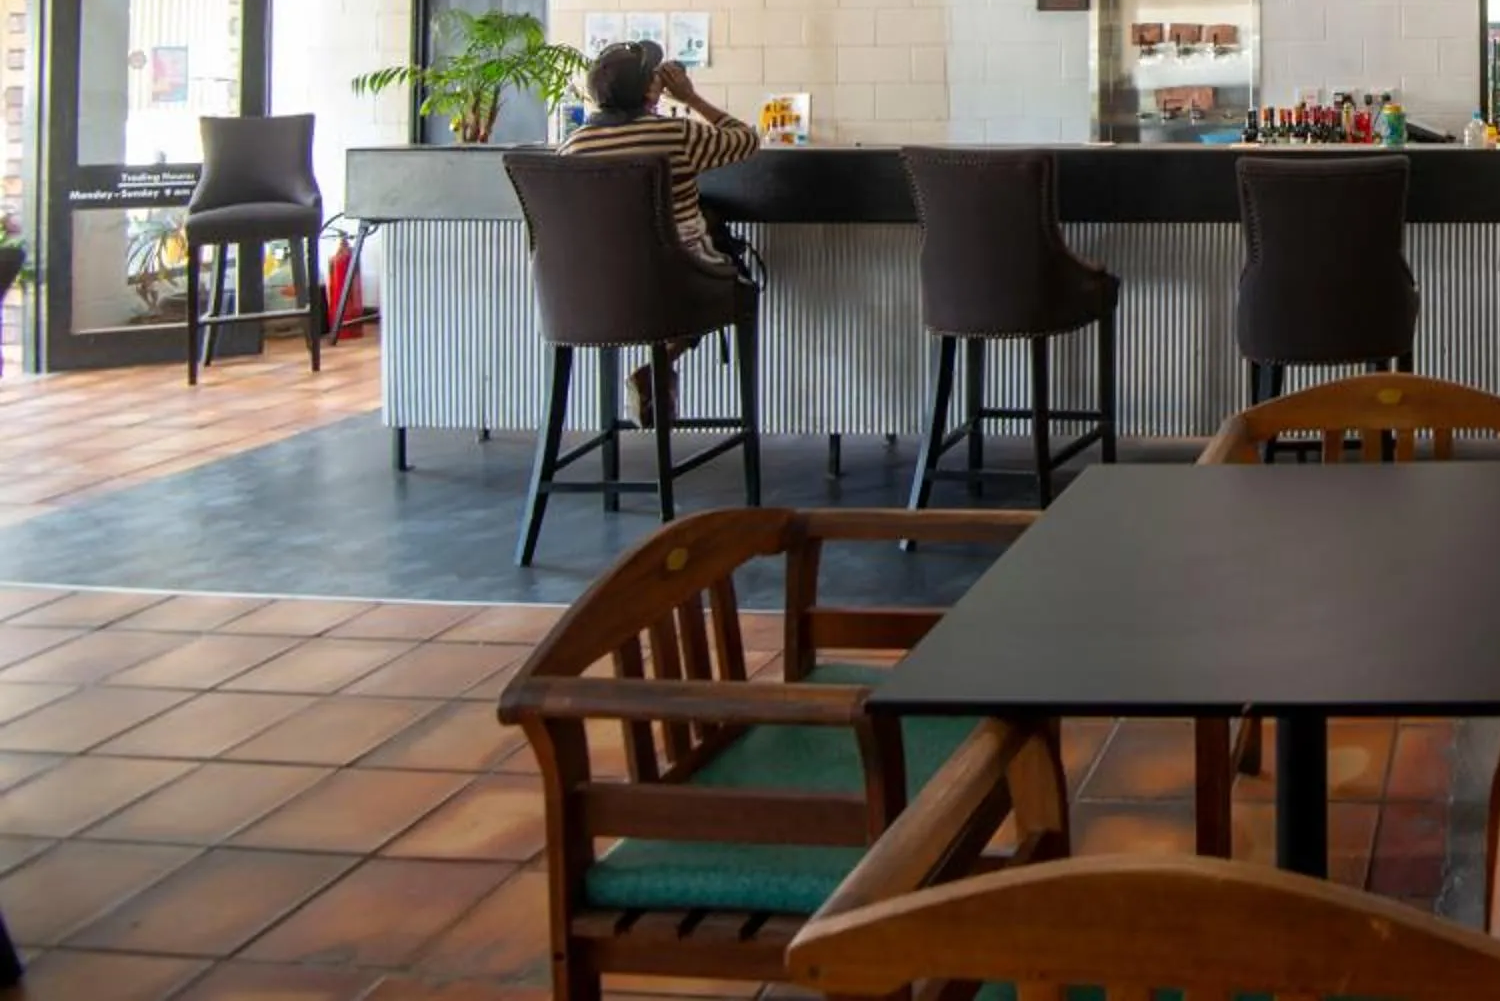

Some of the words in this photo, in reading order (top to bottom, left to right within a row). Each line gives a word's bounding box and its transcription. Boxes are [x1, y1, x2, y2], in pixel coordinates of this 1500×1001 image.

[121, 172, 160, 184] Trading
[69, 190, 112, 200] Monday
[121, 189, 159, 200] Sunday
